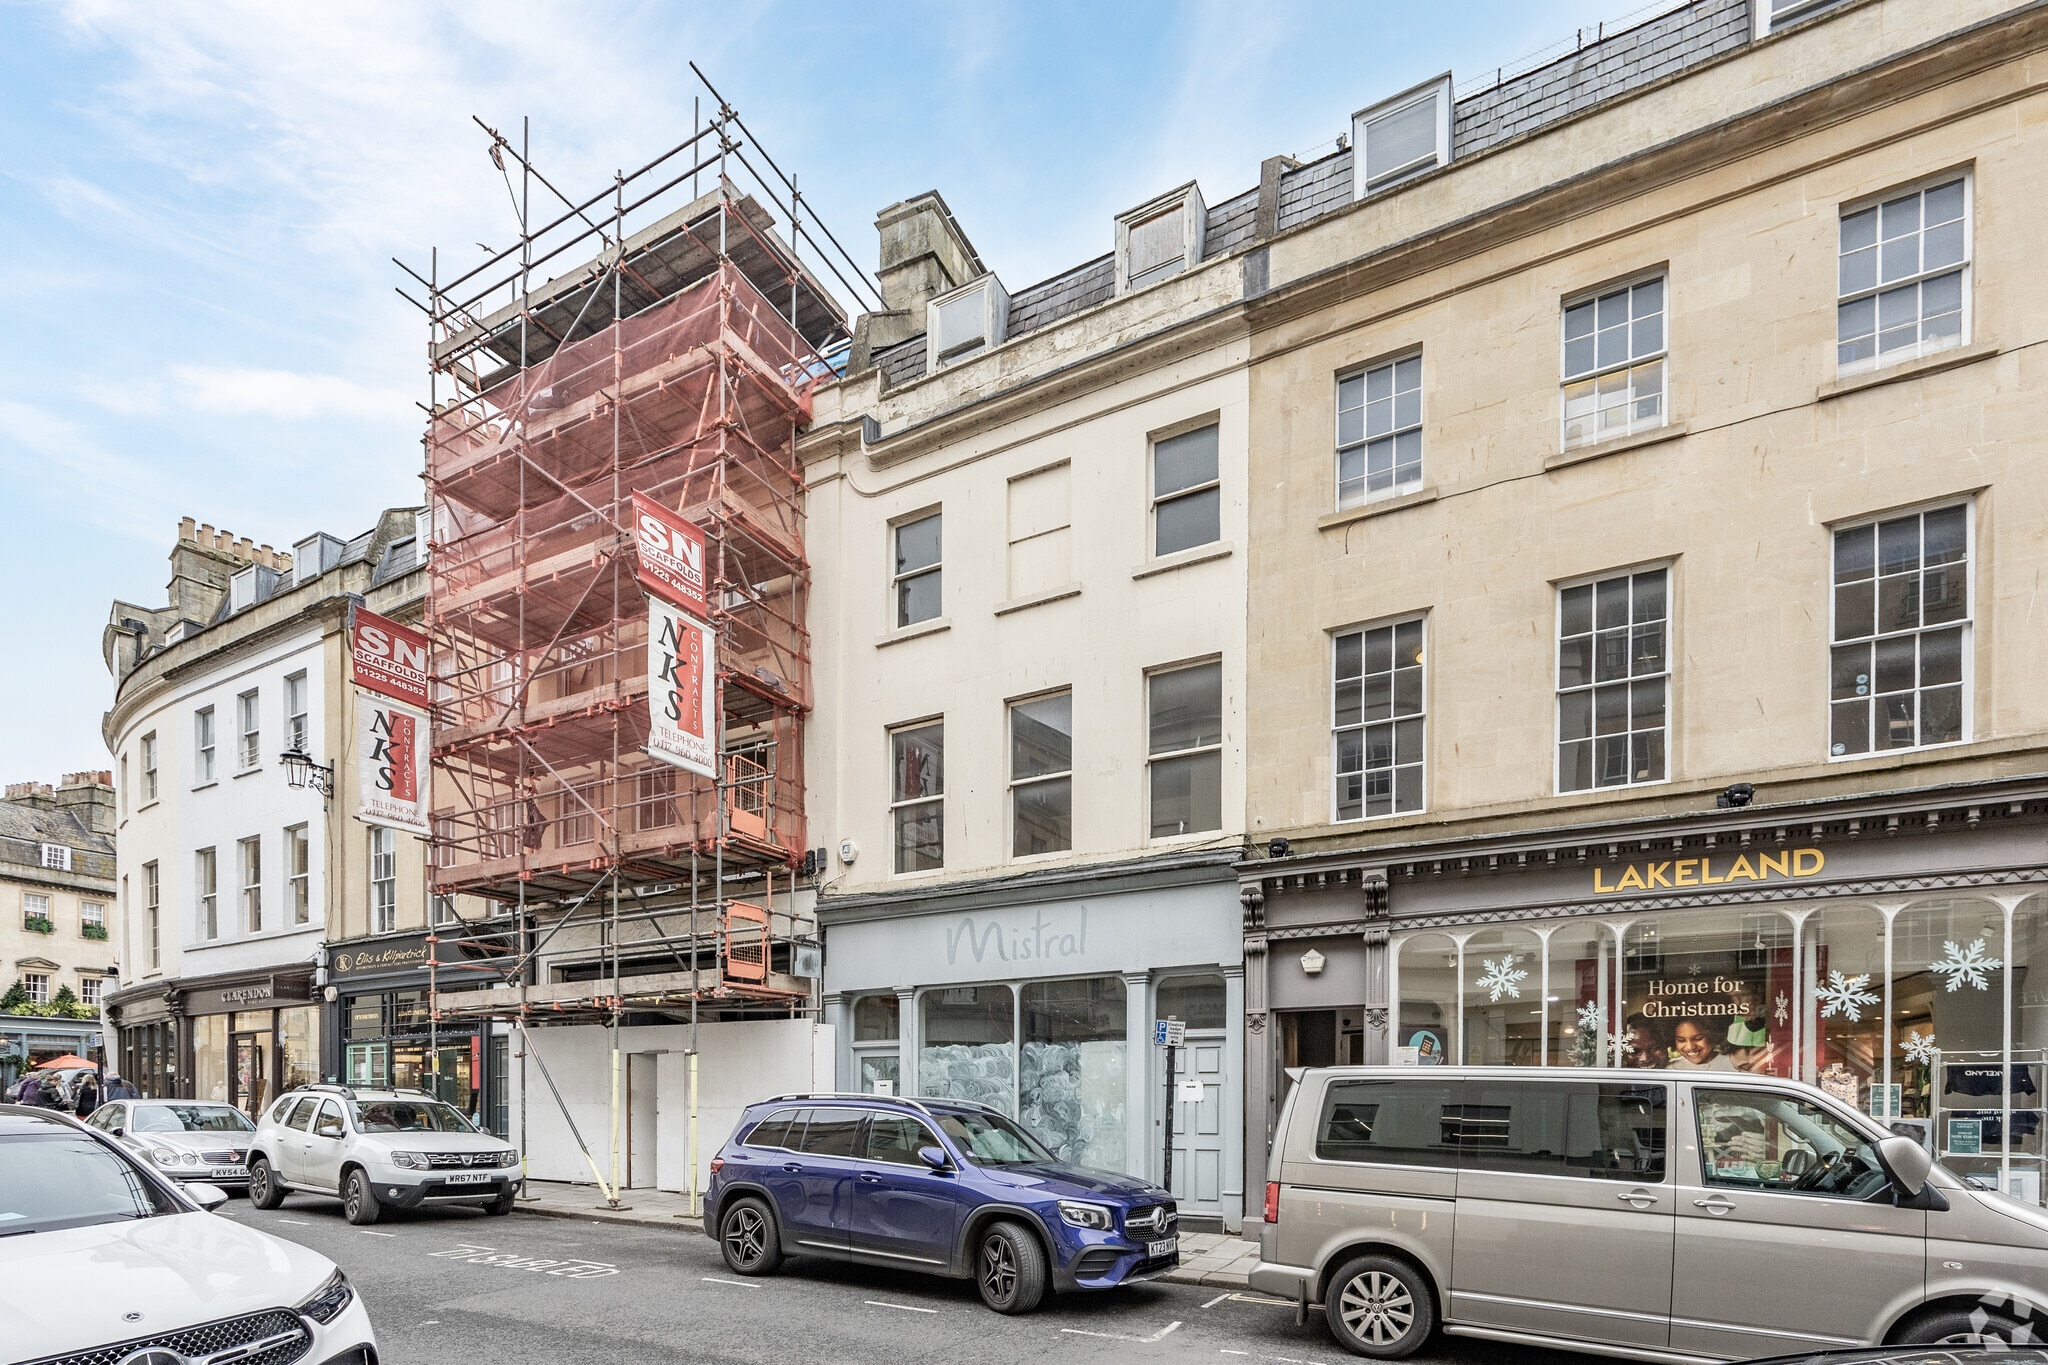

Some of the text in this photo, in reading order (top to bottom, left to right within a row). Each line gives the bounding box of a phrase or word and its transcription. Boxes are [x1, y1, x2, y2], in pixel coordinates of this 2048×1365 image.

[640, 515, 701, 574] SN
[641, 543, 701, 583] SCAFFOLDS
[643, 560, 703, 602] 01225 448352
[356, 650, 425, 682] SCAFFOLDS
[358, 626, 426, 673] SN
[356, 665, 425, 696] 01225 448352
[658, 615, 687, 722] NKS
[690, 631, 699, 731] CONTRACTS
[369, 709, 400, 791] NKS
[653, 737, 713, 768] 0117 960 4000
[659, 725, 708, 754] TELEPHONE
[403, 719, 412, 797] CONTRACTS
[371, 799, 420, 818] TELEPHONE
[1594, 848, 1825, 894] LAKELAND
[946, 904, 1088, 966] Mistral
[221, 986, 271, 1005] CLARENDON
[1647, 975, 1744, 996] Home for
[1642, 1001, 1750, 1018] Christmas
[449, 1173, 488, 1182] WR67 NTF
[427, 1244, 621, 1279] DISABLED
[1151, 1241, 1166, 1255] KT23
